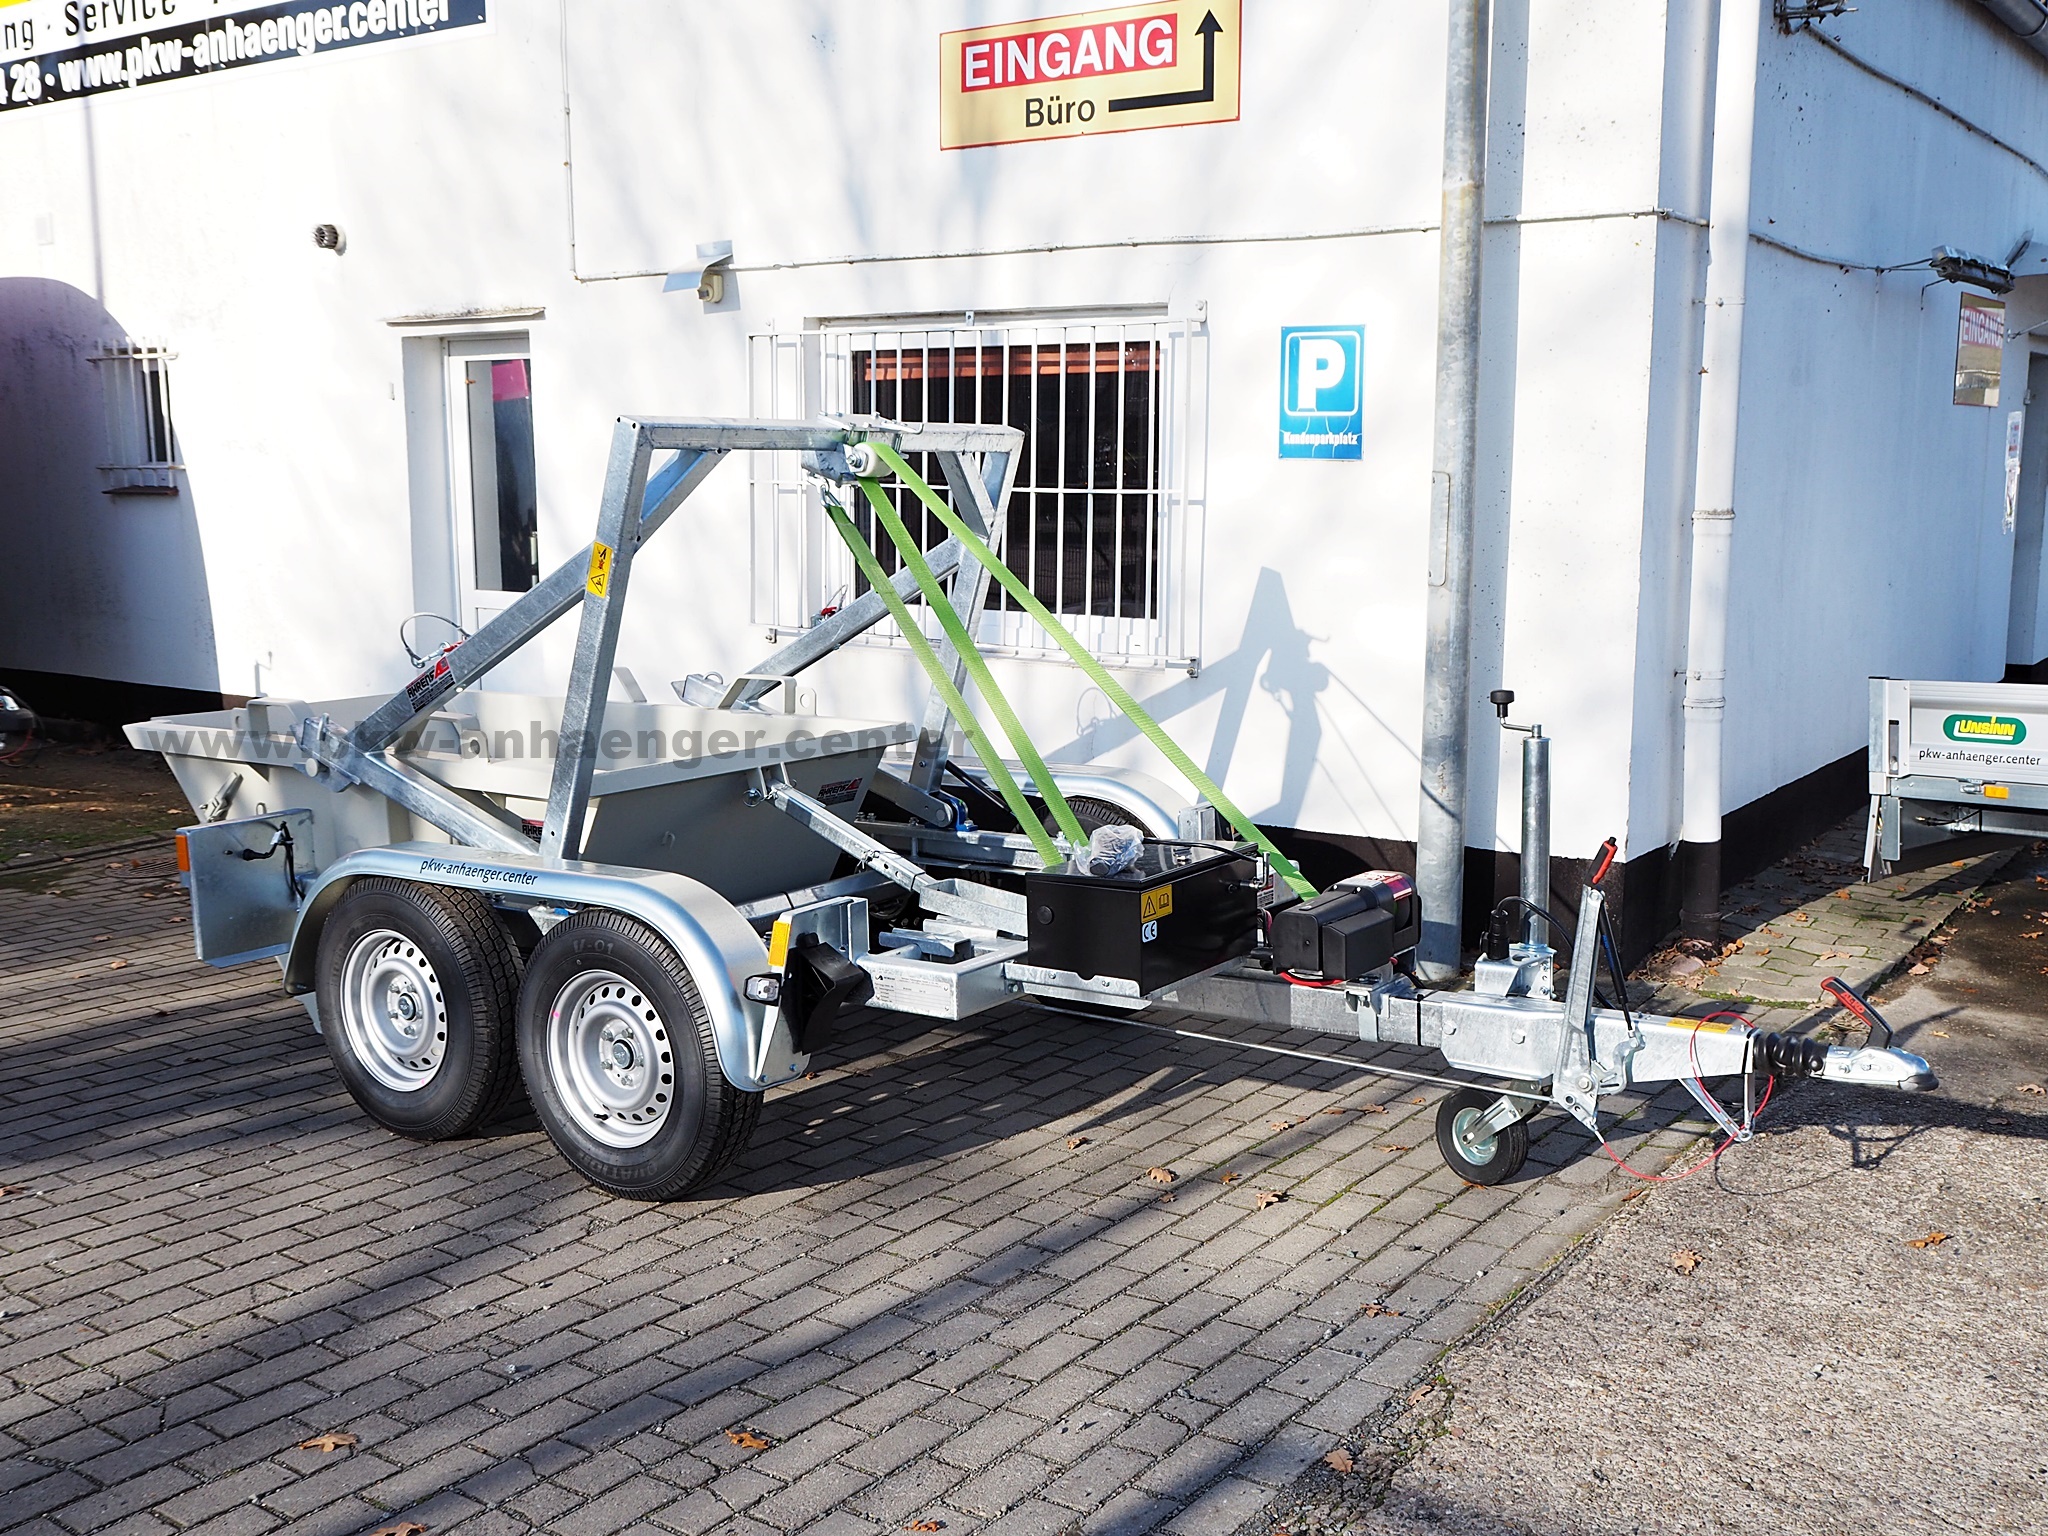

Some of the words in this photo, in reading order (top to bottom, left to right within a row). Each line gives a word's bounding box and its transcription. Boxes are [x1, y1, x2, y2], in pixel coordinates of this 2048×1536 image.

[57, 0, 449, 88] www.pkw-anhaenger.center
[965, 18, 1173, 88] EINGANG
[1025, 95, 1096, 128] Büro
[1297, 338, 1346, 410] P
[1283, 431, 1359, 447] Kundenparkplatz
[1958, 715, 2017, 736] UNSINN
[1918, 748, 2042, 766] pkw-anhaenger.center
[419, 858, 539, 886] pkw-anhaenger.center
